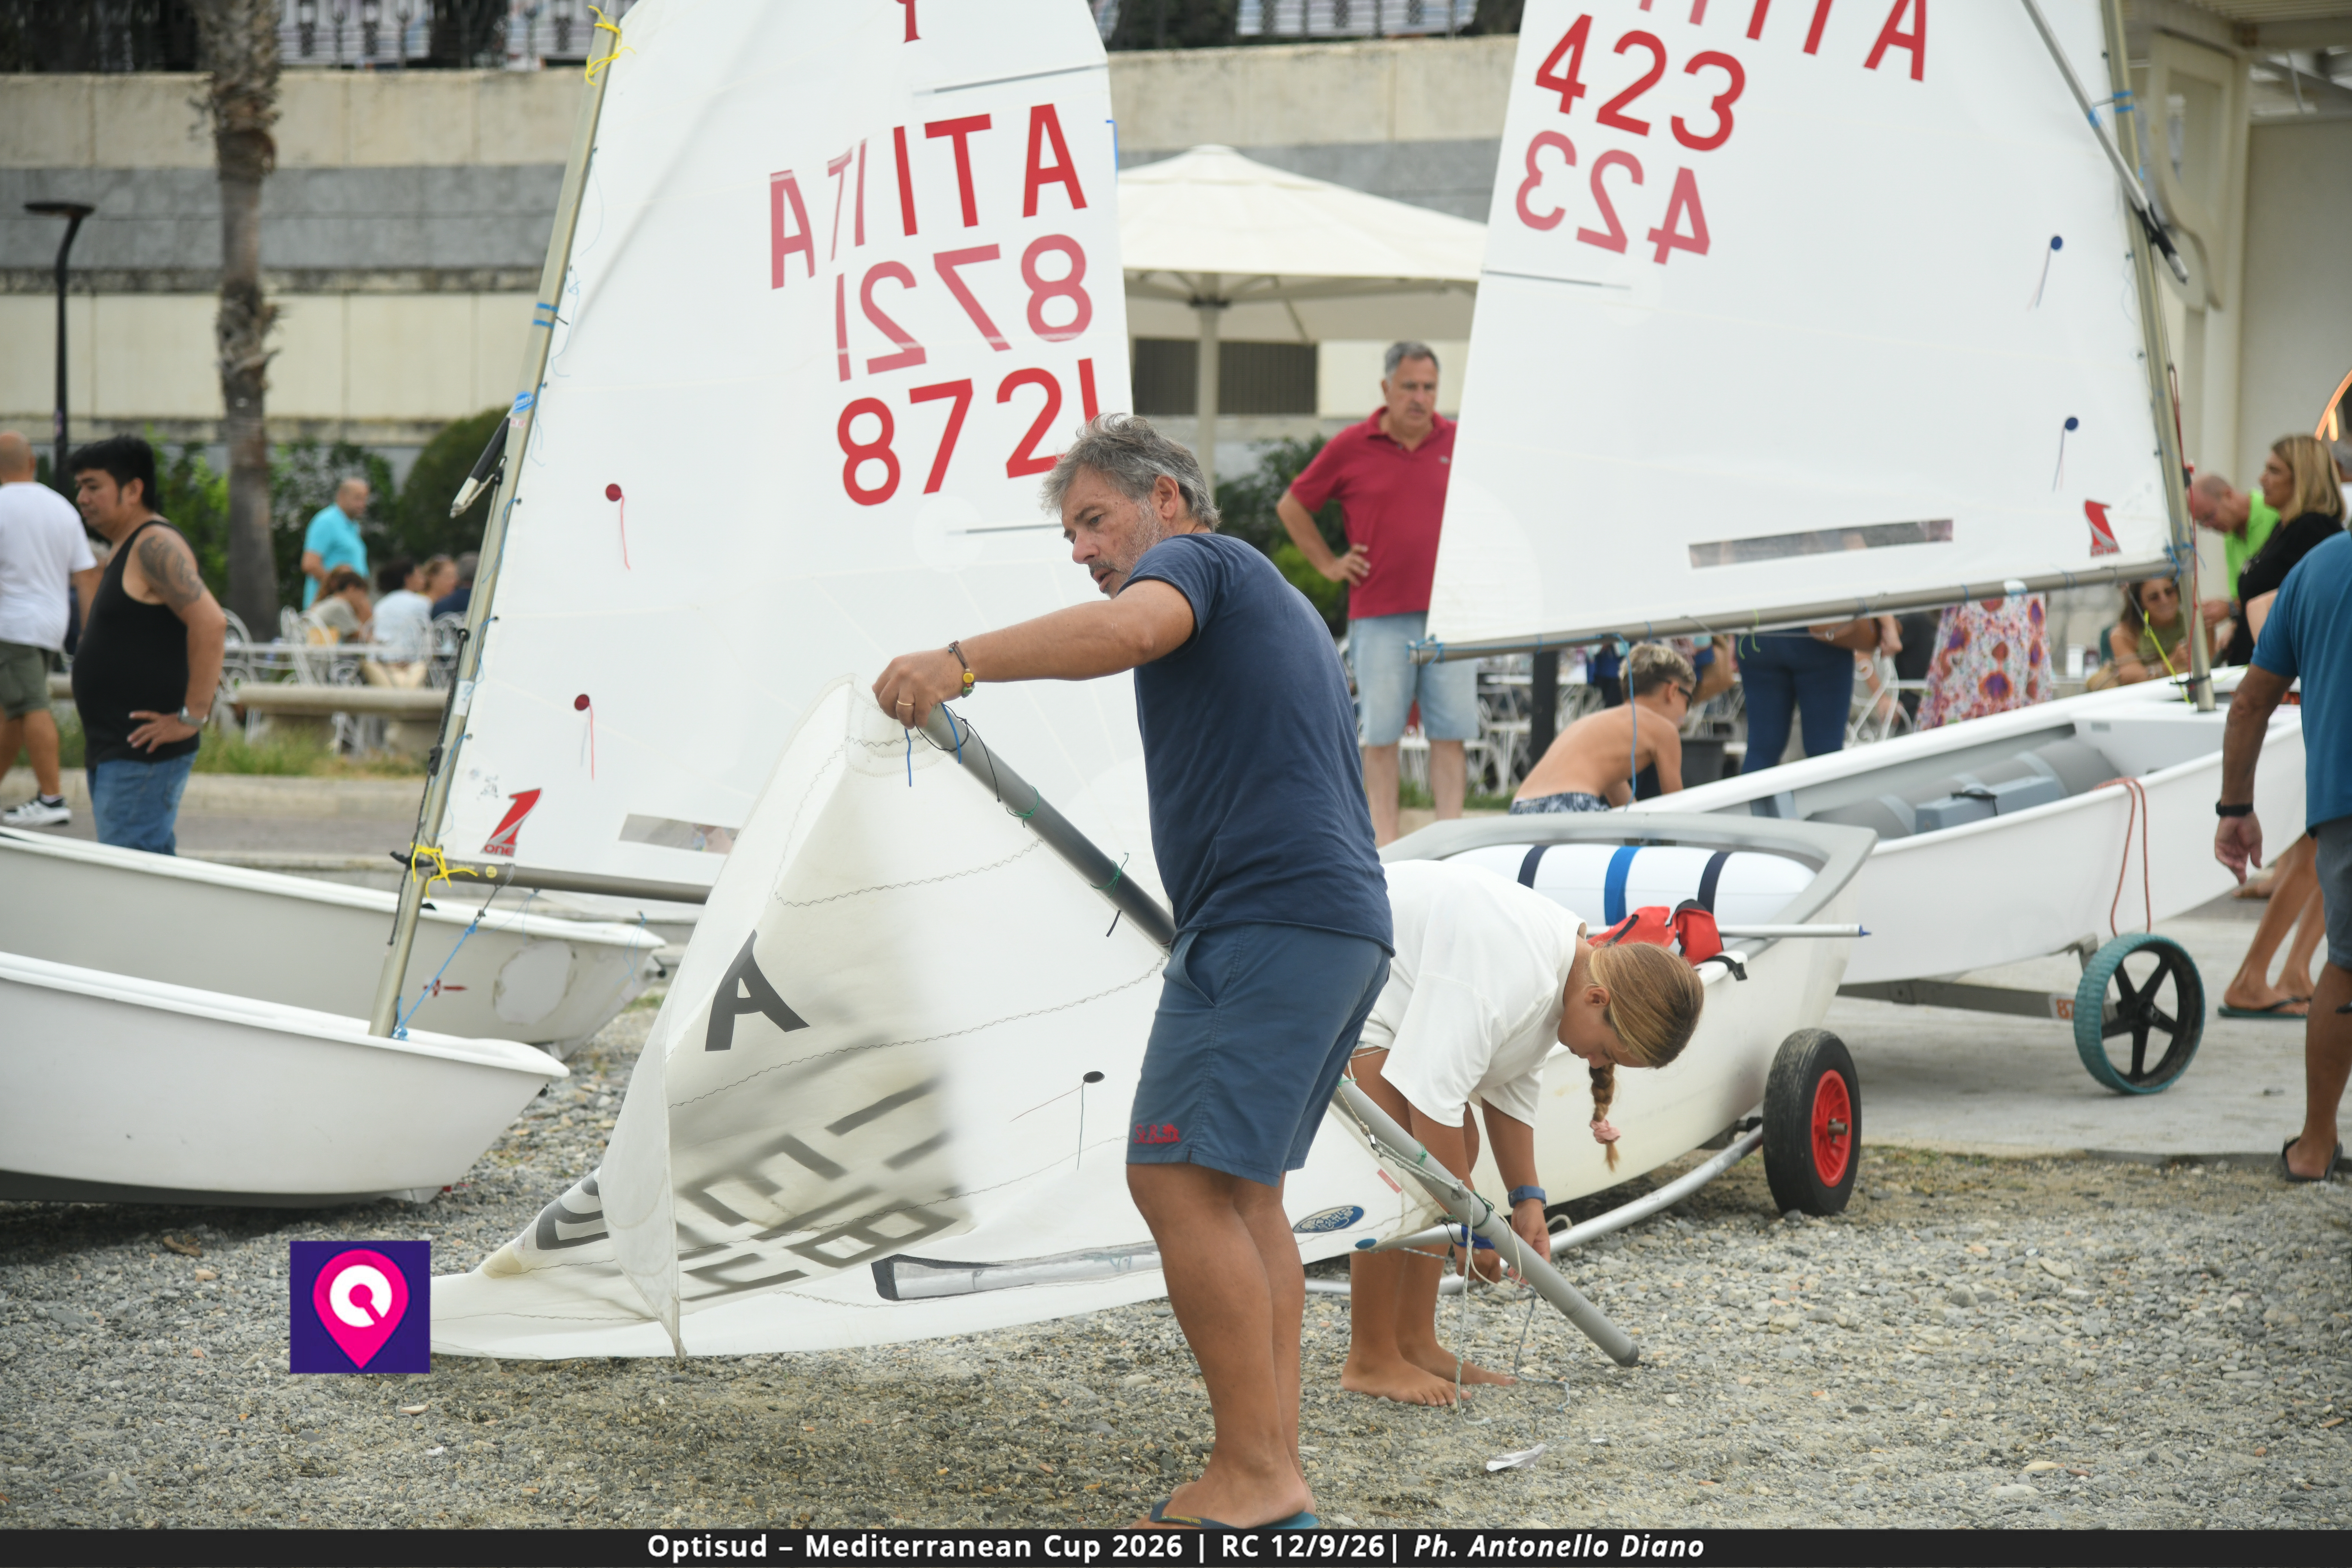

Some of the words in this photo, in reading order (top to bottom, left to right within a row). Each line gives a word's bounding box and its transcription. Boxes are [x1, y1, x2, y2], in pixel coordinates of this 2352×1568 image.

[1535, 14, 1746, 152] 423
[893, 103, 1087, 236] ITA
[837, 358, 1099, 506] 8721
